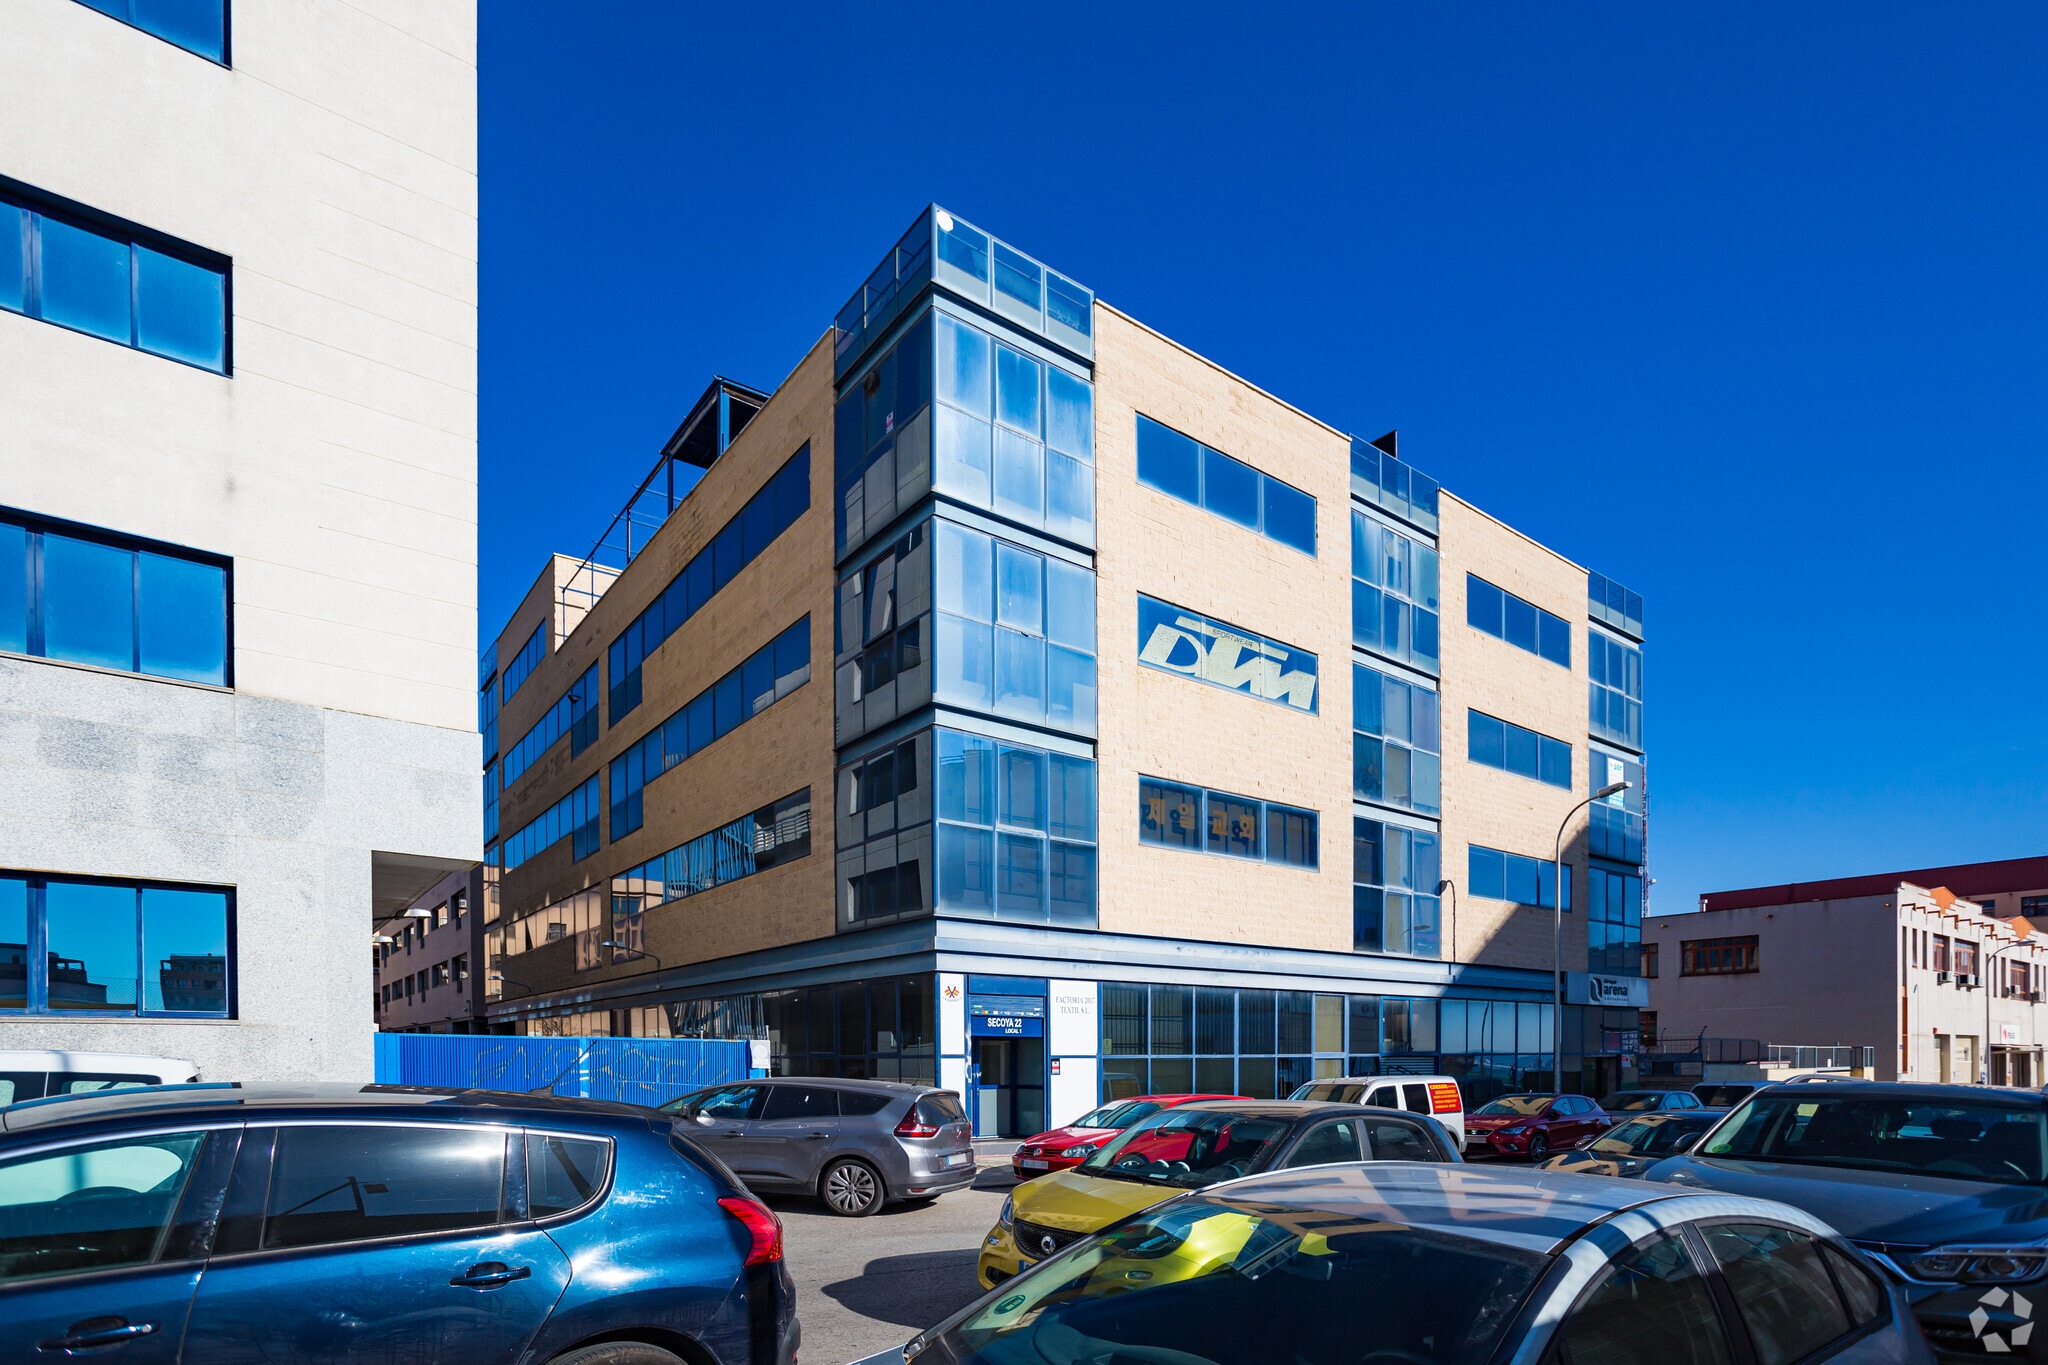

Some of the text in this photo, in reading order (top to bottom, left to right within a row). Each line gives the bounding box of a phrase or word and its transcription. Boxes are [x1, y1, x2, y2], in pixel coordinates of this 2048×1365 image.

[1212, 628, 1254, 648] SPORTWEAR
[1603, 985, 1628, 996] arena
[1055, 996, 1084, 1004] FACTORIA
[1060, 1006, 1080, 1014] TEXTIL
[987, 1018, 1023, 1028] SECOYA 22
